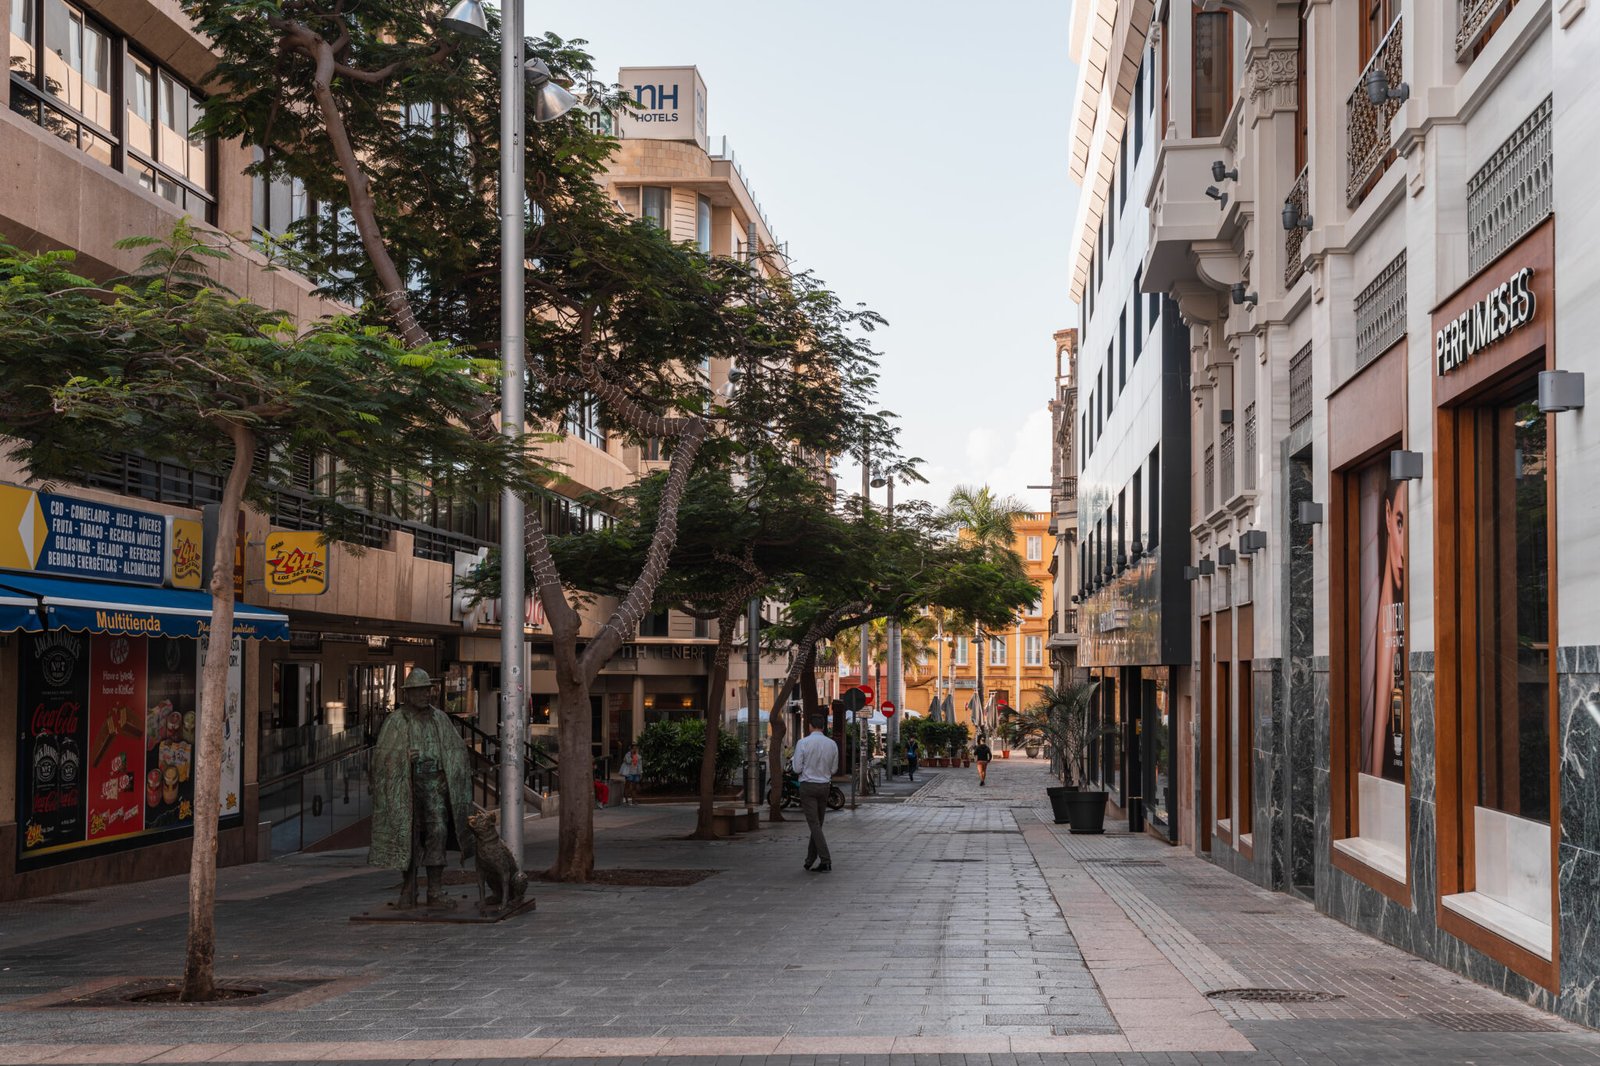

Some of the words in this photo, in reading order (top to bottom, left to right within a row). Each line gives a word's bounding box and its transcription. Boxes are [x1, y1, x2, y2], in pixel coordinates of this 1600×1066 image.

[634, 84, 679, 110] nH
[636, 112, 679, 123] HOTELS
[50, 500, 64, 516] CBD
[70, 504, 110, 525] CONGELADOS
[115, 512, 133, 528] HIELO
[52, 518, 73, 534] FRUTA
[80, 522, 103, 539] TABACO
[109, 528, 136, 544] RECARGA
[55, 535, 91, 553] GOLOSINAS
[96, 541, 124, 558] HELADOS
[129, 546, 161, 563] REFRESCOS
[276, 551, 316, 573] 24H
[48, 551, 76, 568] BEBIDAS
[77, 555, 117, 573] ENERGÉTICAS
[123, 561, 161, 578] ALCOHÓLICAS
[96, 610, 161, 632] Multitienda
[651, 645, 705, 659] TENERIF
